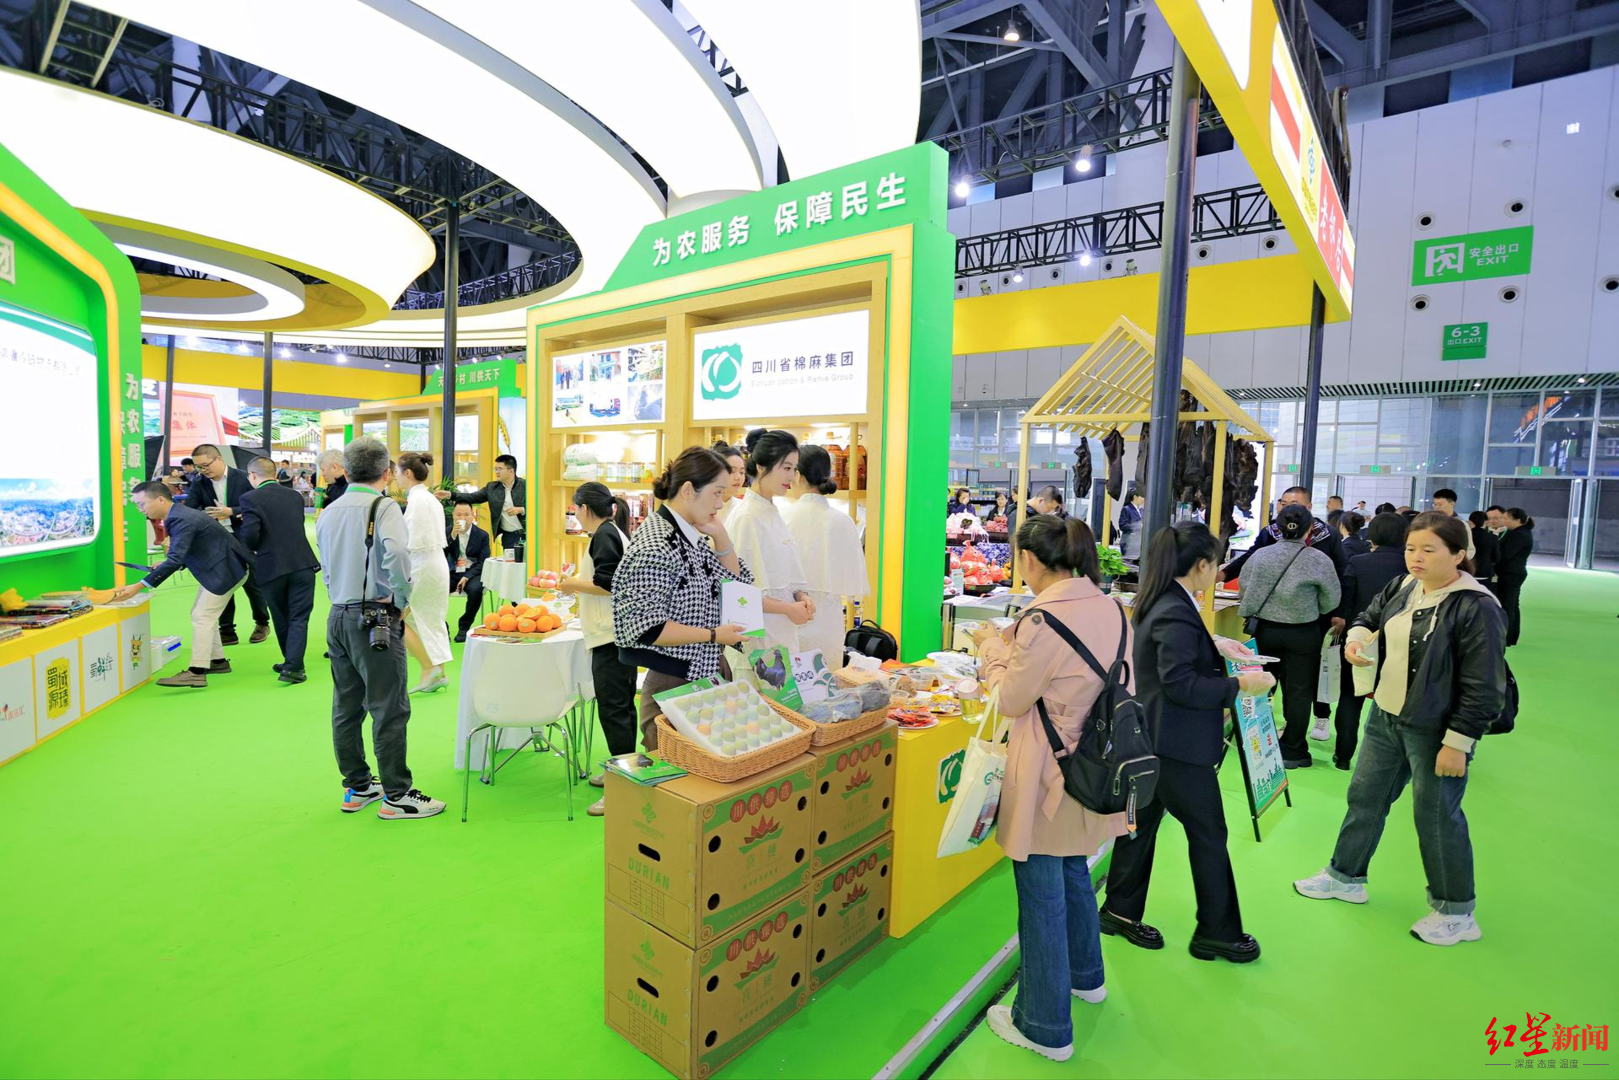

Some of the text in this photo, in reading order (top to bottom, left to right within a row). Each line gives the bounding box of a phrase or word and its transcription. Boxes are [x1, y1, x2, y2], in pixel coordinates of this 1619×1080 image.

[652, 172, 907, 267] 为农服务 保障民生
[1469, 243, 1519, 259] 安全出口
[1476, 255, 1509, 266] EXIT
[1451, 325, 1481, 338] 6-3
[1462, 336, 1483, 345] EXIT
[752, 351, 854, 374] 四川省棉麻集团
[469, 368, 500, 383] 川供天下
[830, 373, 854, 382] Group
[628, 857, 670, 891] DURIAN
[627, 988, 668, 1026] DURIAN
